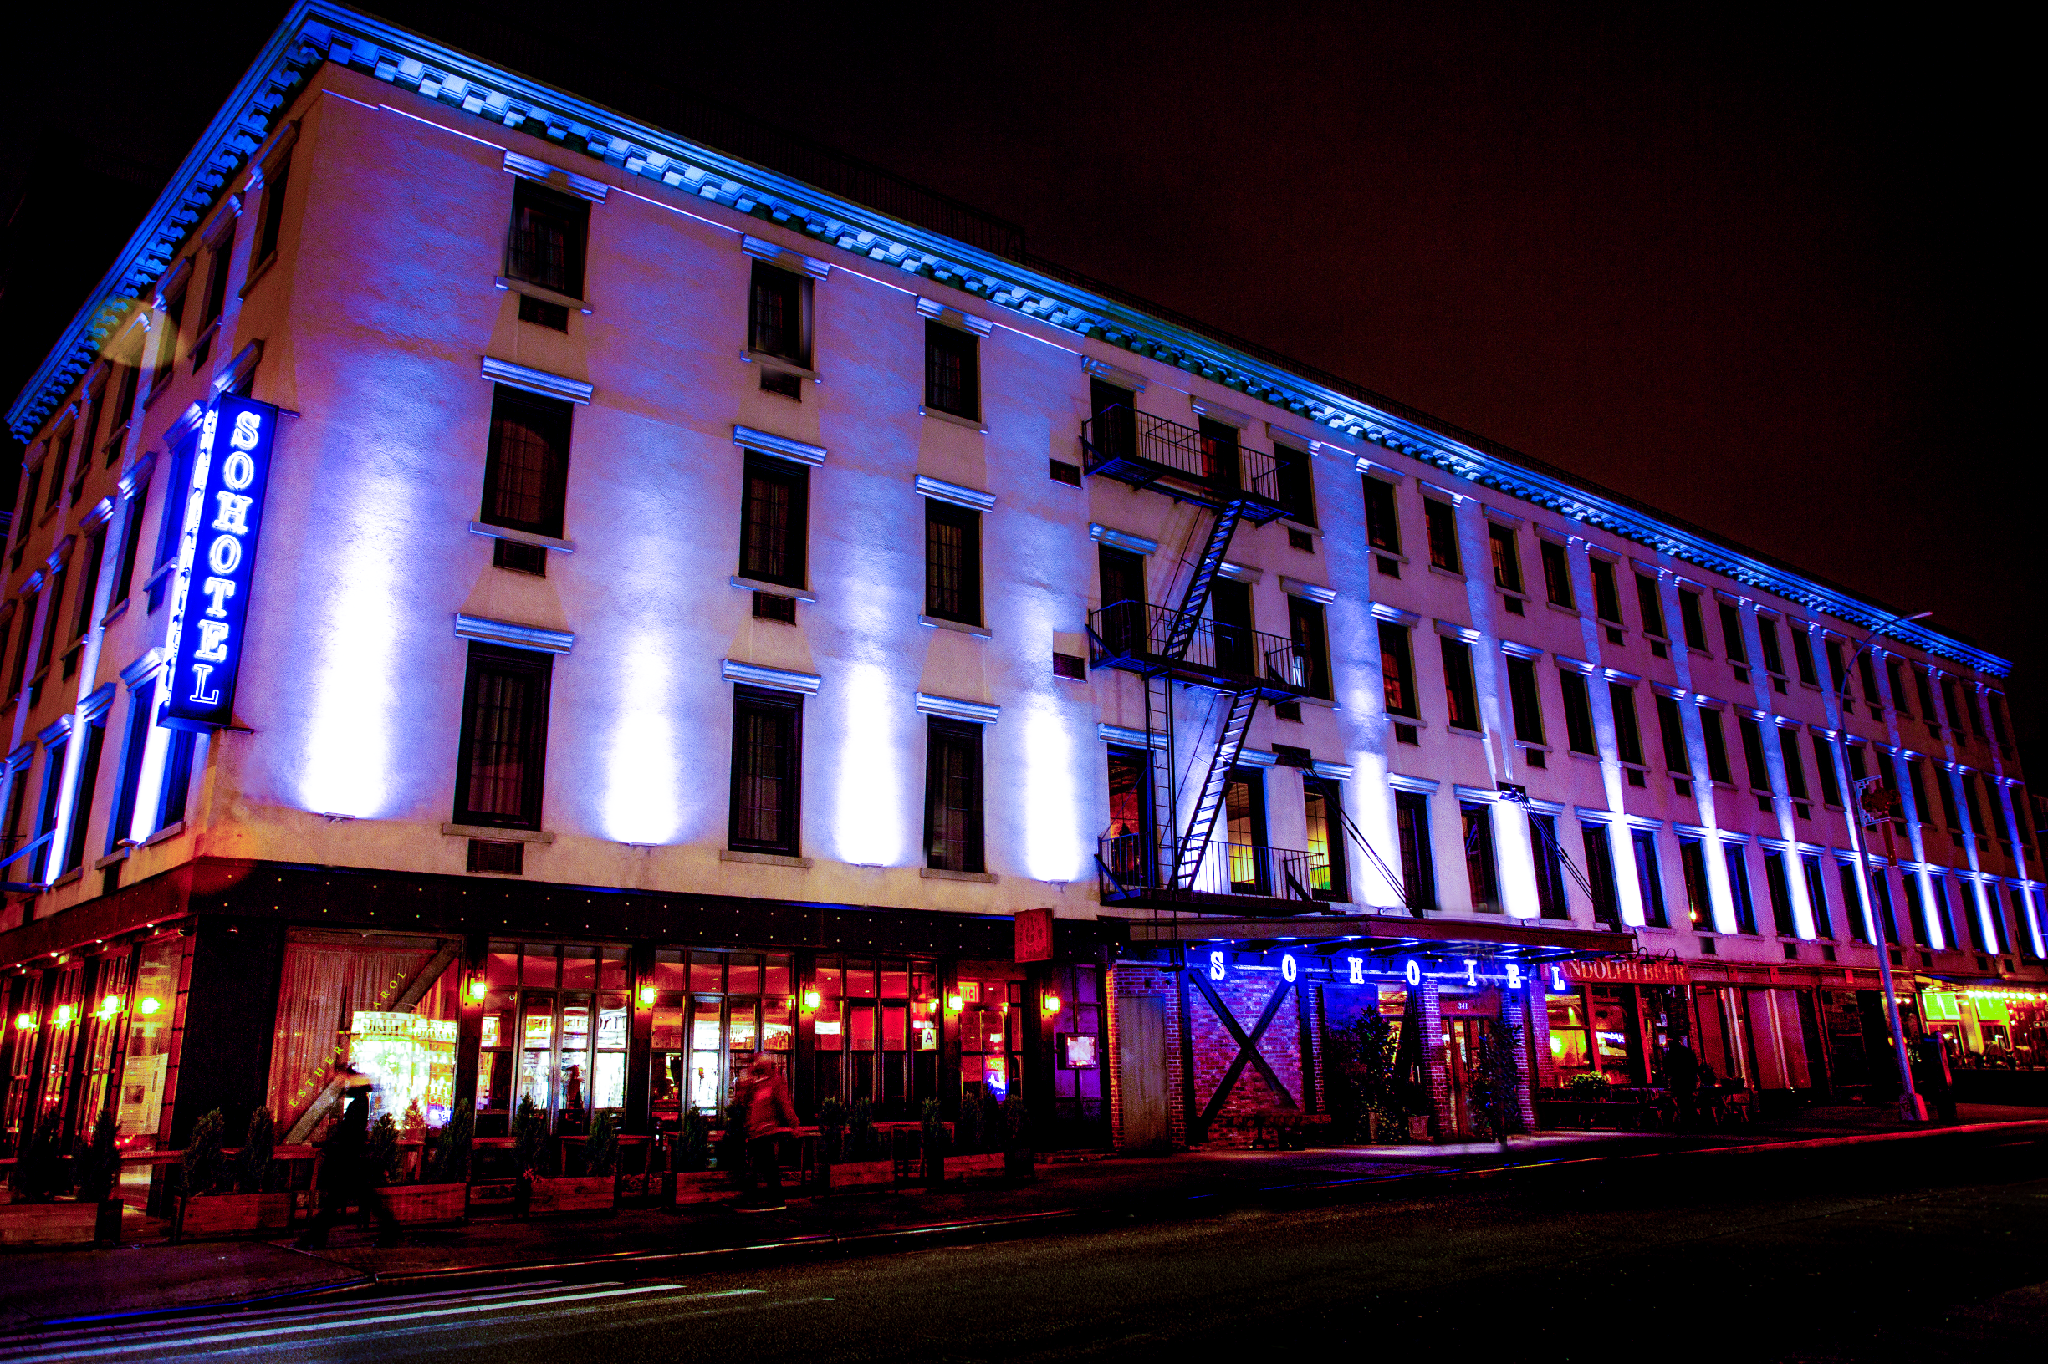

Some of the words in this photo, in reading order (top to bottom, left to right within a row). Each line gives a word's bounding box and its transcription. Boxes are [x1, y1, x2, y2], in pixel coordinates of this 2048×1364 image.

[190, 410, 261, 705] SOHOTEL
[1210, 951, 1566, 991] SOHOTEL
[1643, 963, 1684, 981] BEER
[289, 1046, 344, 1108] ESTHER
[372, 971, 407, 1011] AROL
[925, 1031, 933, 1043] A
